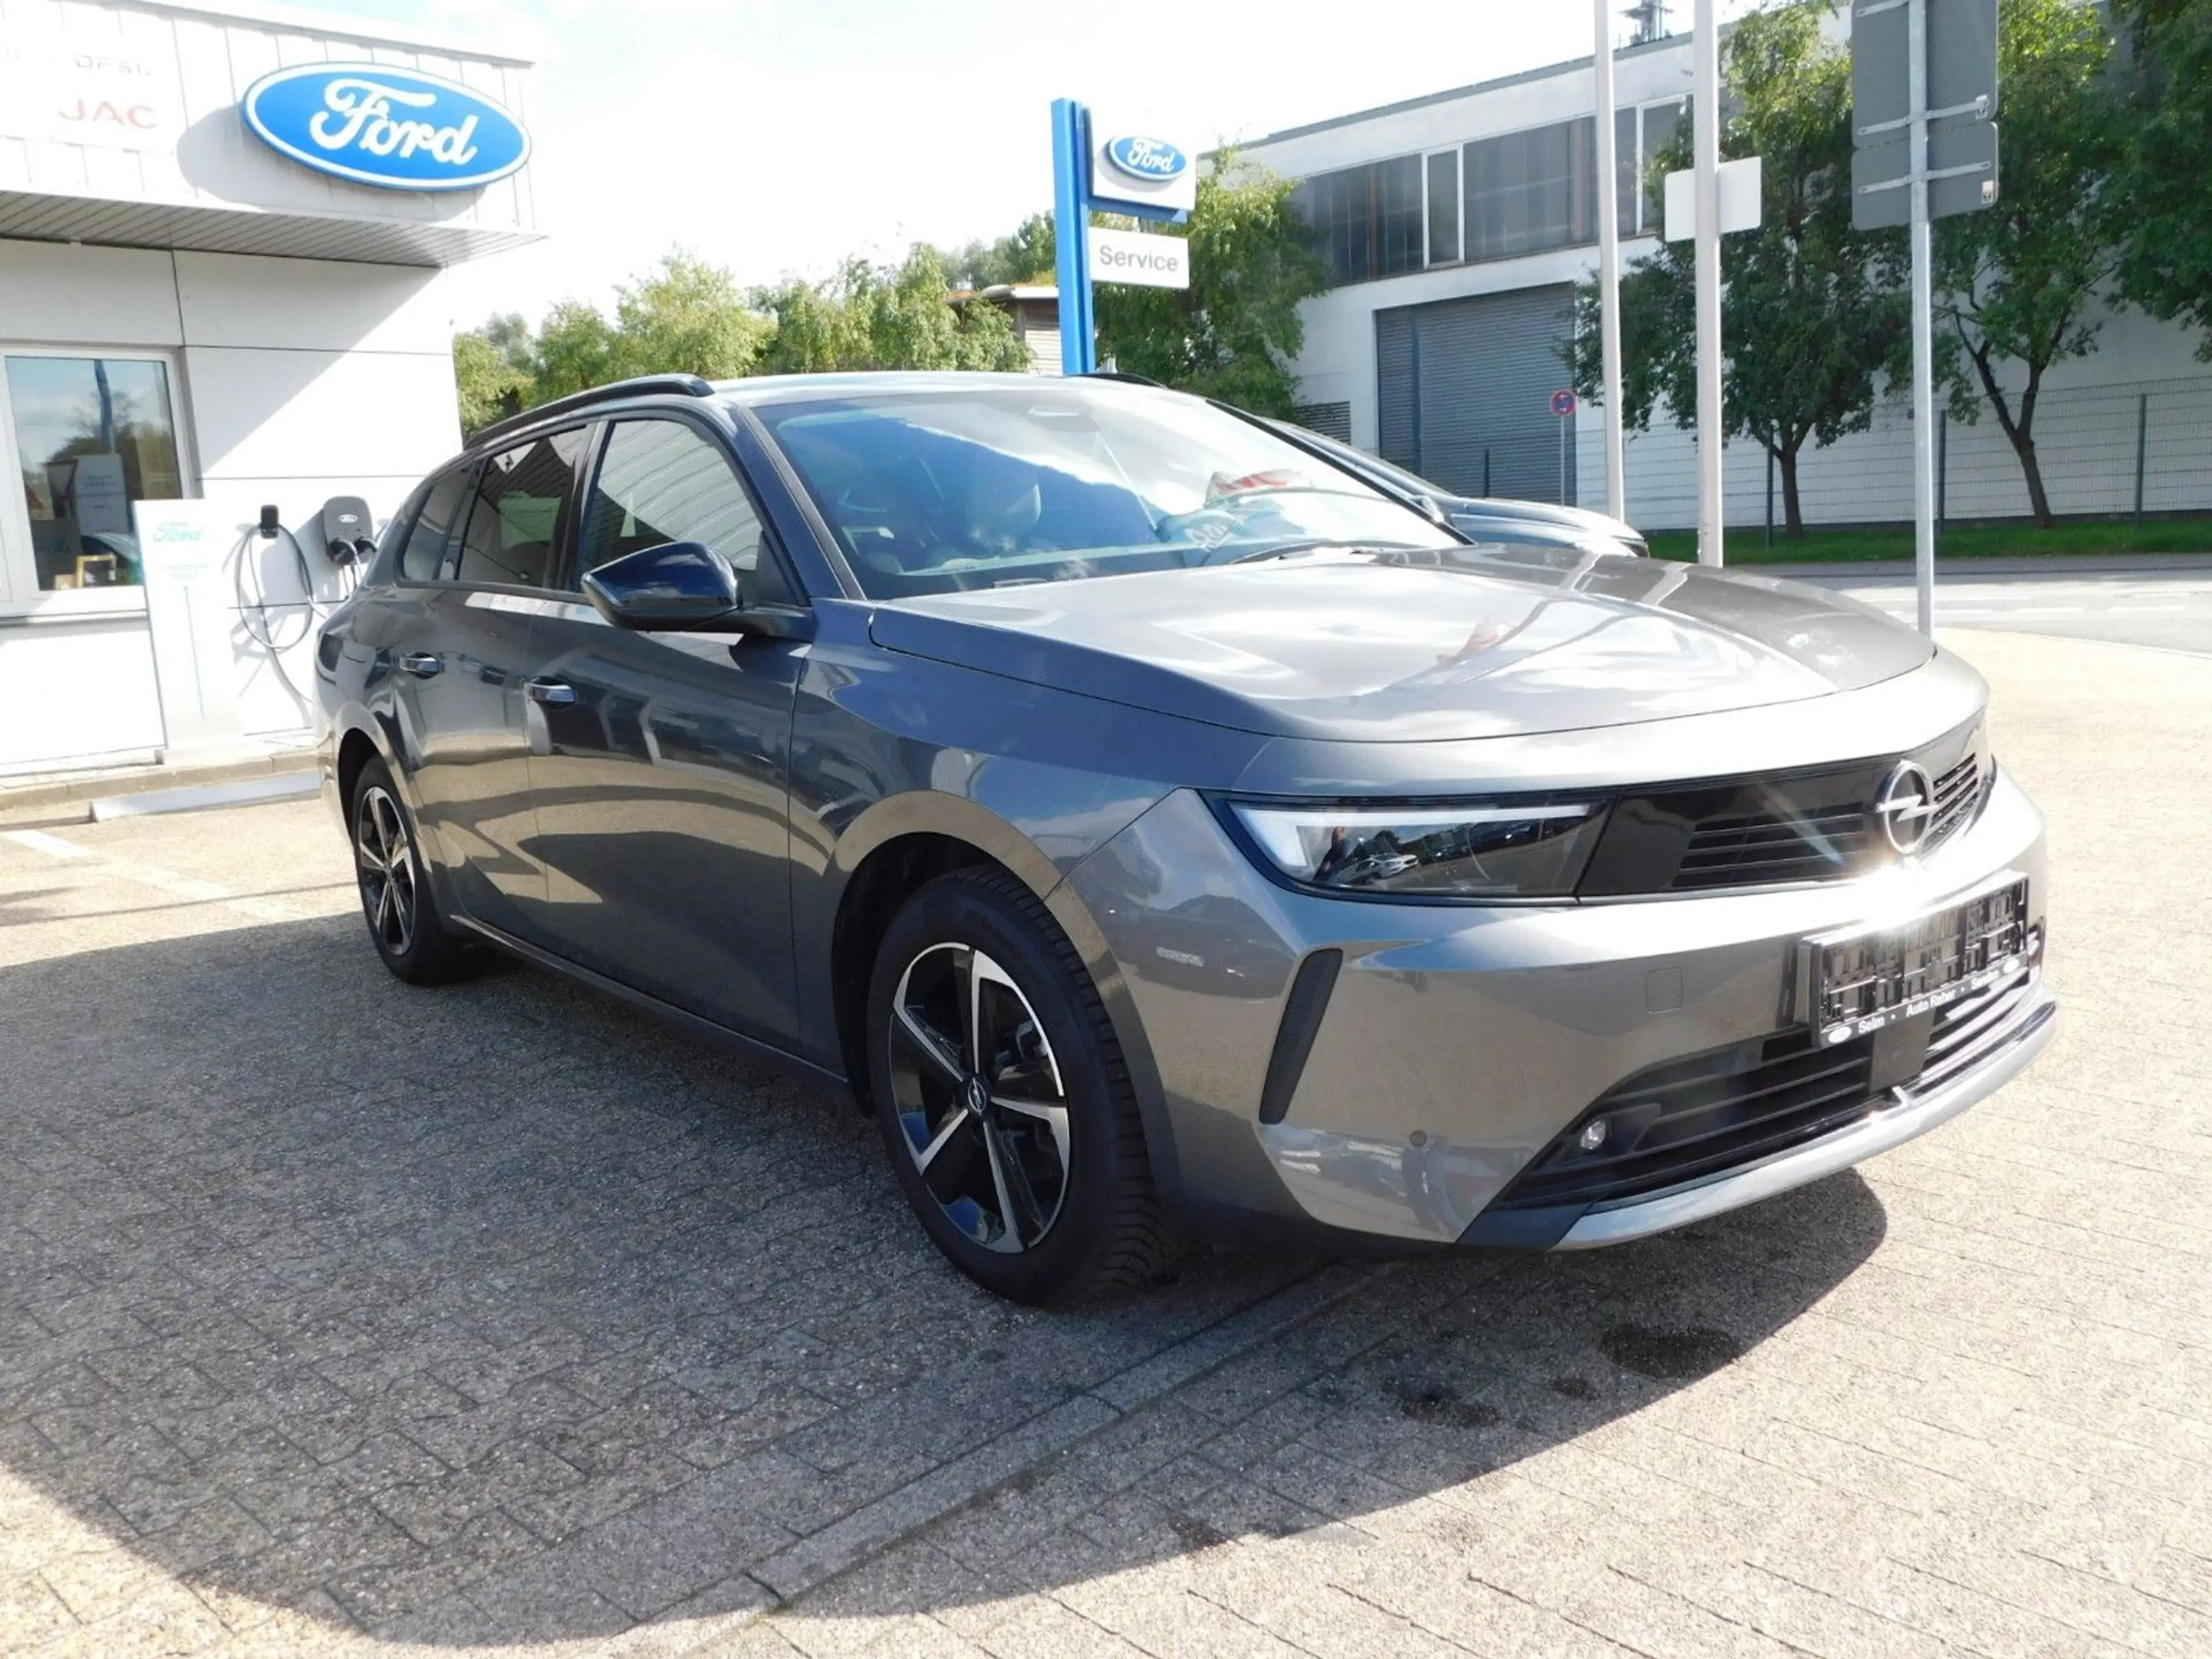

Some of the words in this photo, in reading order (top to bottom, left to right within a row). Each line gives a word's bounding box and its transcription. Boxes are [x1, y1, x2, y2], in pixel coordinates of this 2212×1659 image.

[58, 98, 158, 129] JAC
[310, 79, 478, 165] Ford
[1127, 137, 1175, 172] Ford
[1099, 245, 1179, 272] Service
[1906, 1000, 1929, 1017] Auto
